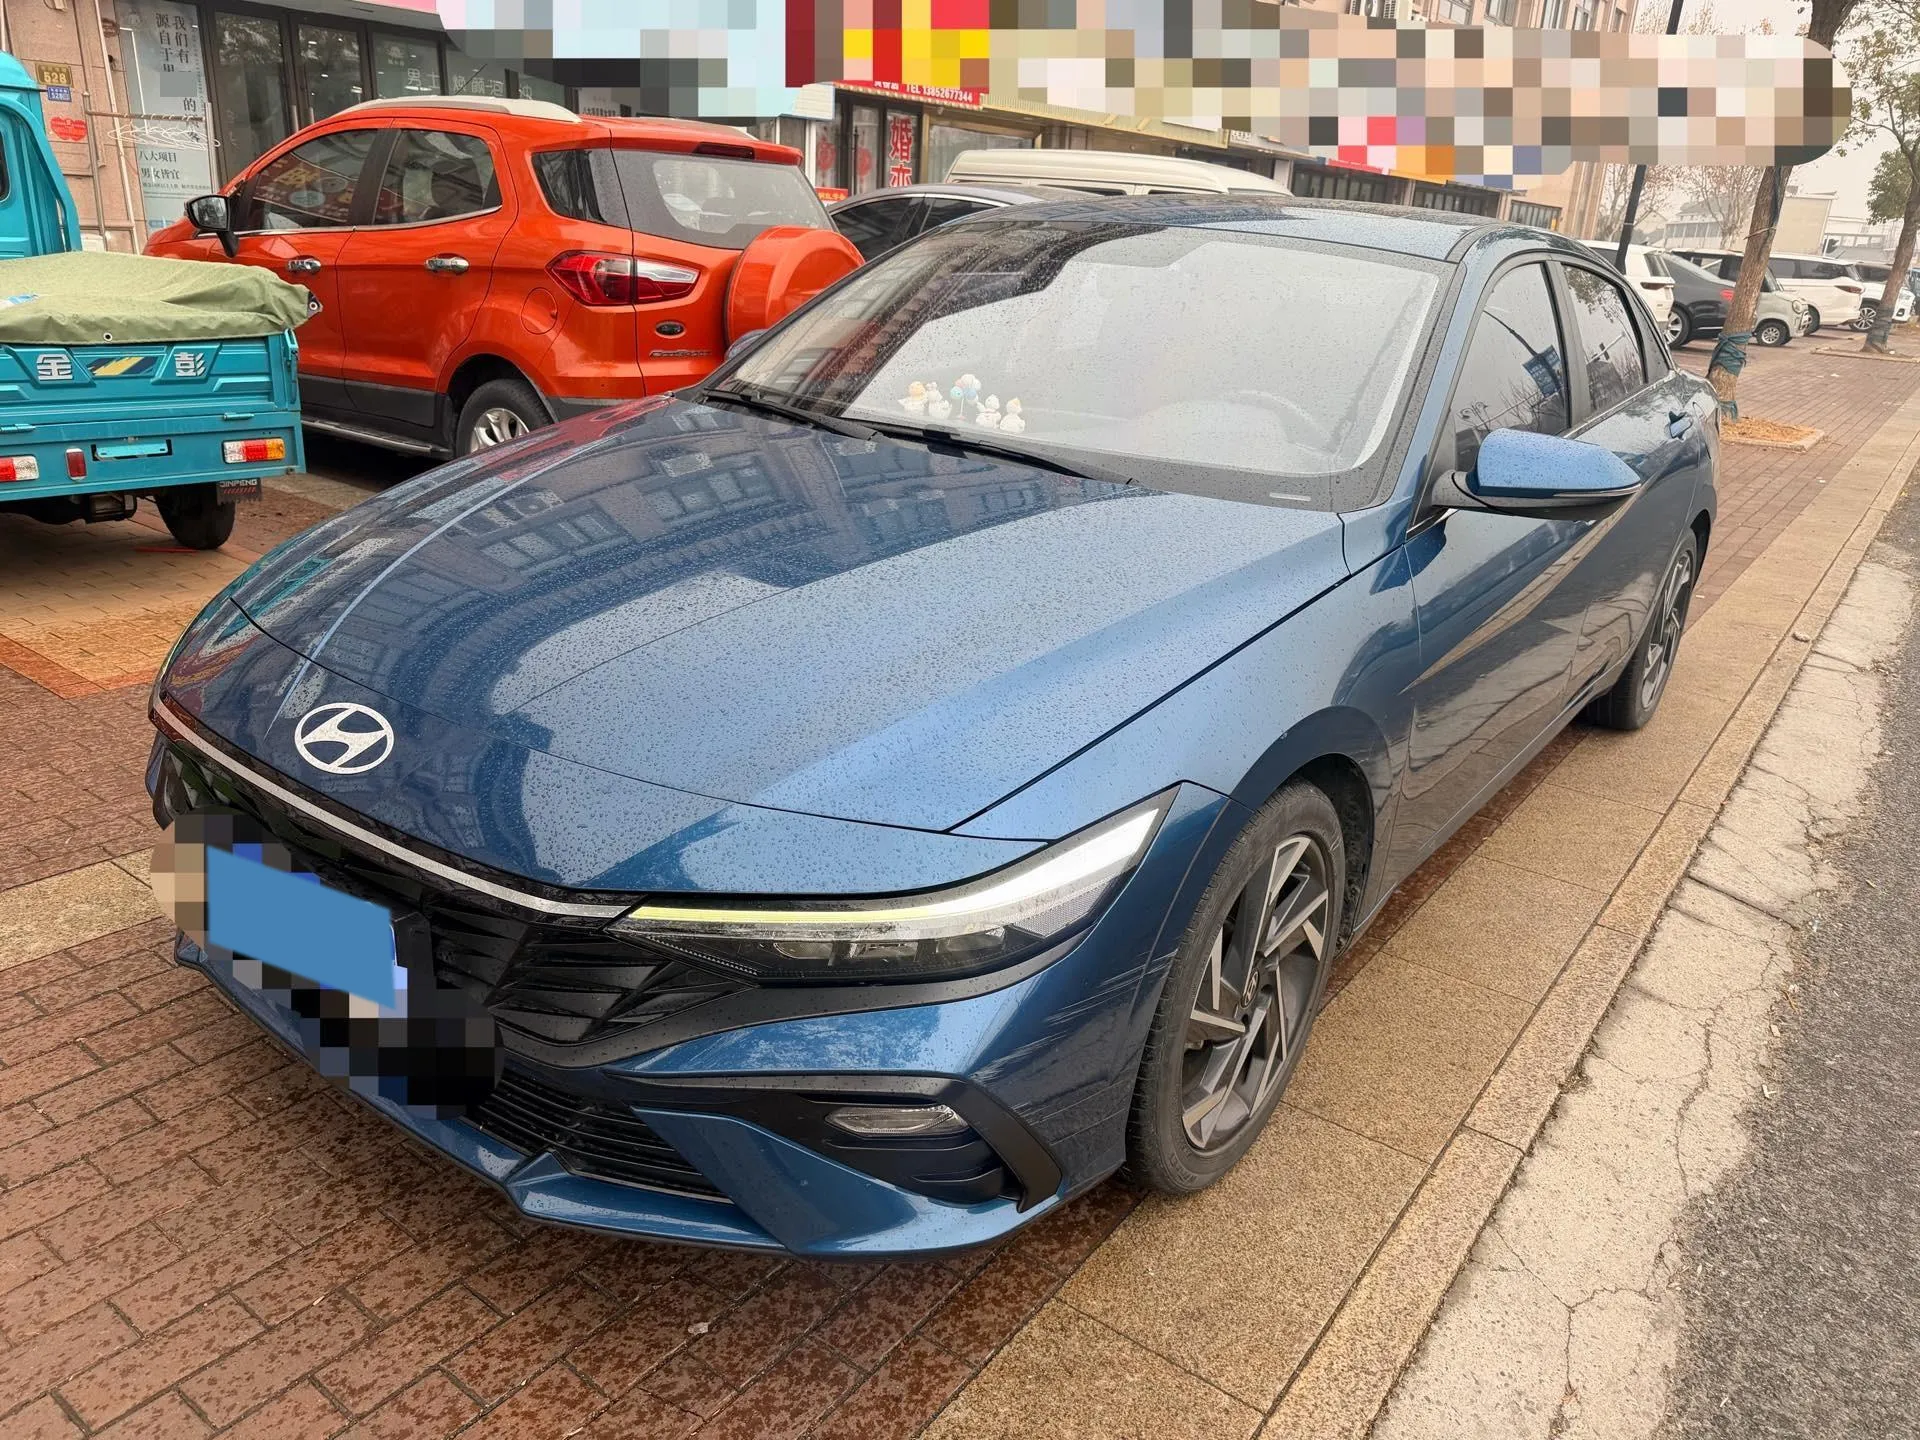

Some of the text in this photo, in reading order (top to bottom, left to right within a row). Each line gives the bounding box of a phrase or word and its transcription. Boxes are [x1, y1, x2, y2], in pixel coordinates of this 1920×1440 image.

[44, 71, 67, 84] 528
[139, 151, 177, 163] 八大项目
[37, 352, 207, 381] 金 彭
[219, 479, 258, 487] JINPENG
